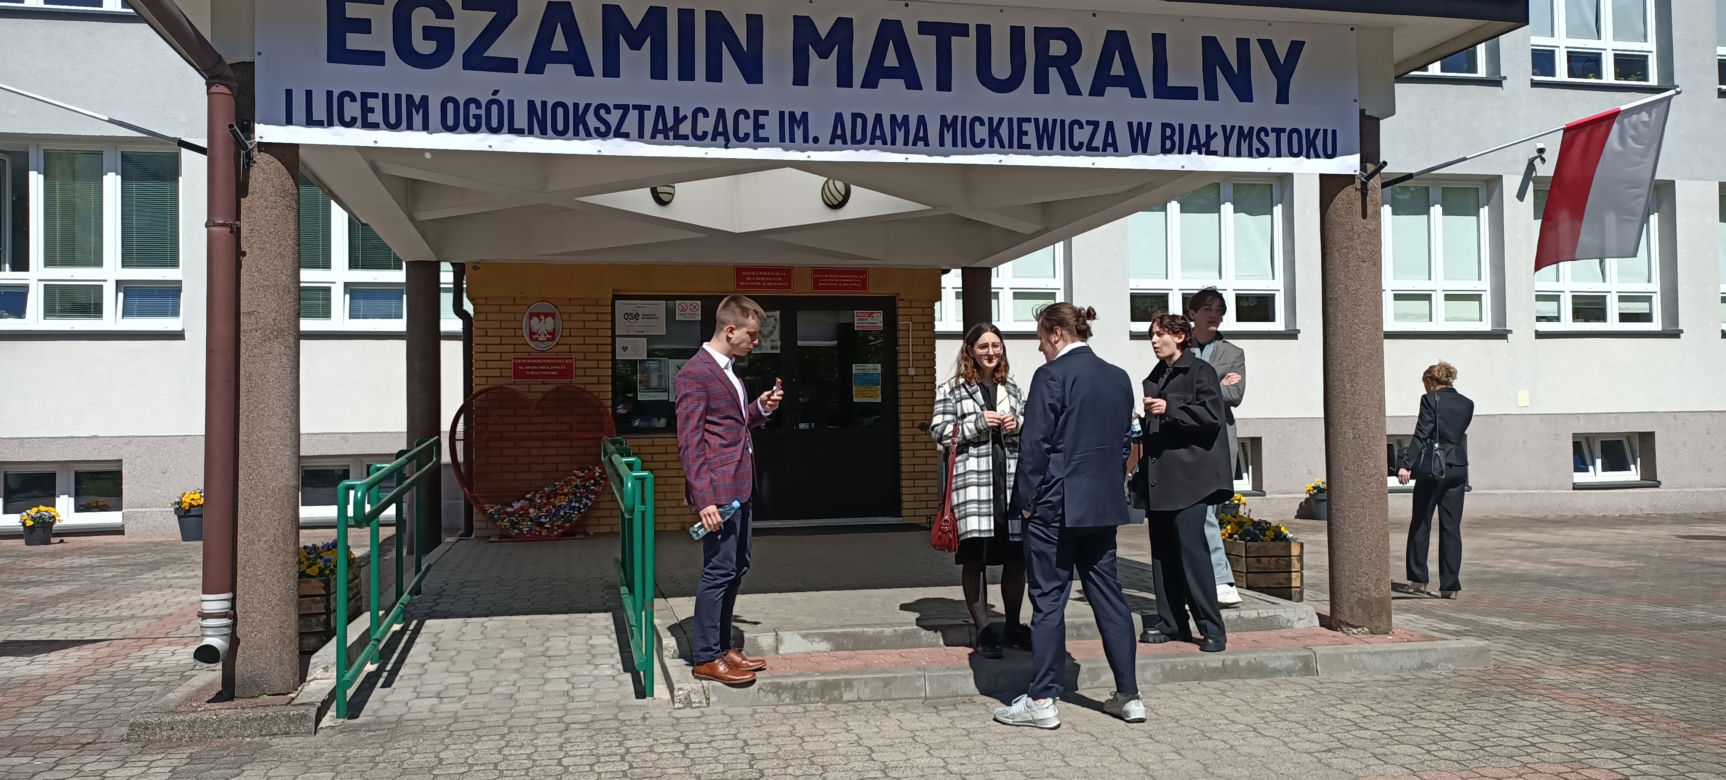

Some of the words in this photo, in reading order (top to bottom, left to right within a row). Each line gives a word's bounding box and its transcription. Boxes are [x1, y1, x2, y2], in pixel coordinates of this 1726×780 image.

[326, 0, 764, 85] EGZAMIN
[791, 15, 1305, 105] MATURALNY
[284, 88, 293, 126] I
[304, 89, 430, 132] LICEUM
[440, 89, 770, 150] OGÓLNOKSZTAŁCĄCE
[778, 110, 820, 145] IM.
[829, 111, 931, 148] ADAMA
[938, 114, 1119, 153] MICKIEWICZA
[1126, 120, 1153, 154] W
[1159, 121, 1338, 160] BIAŁYMSTOKU
